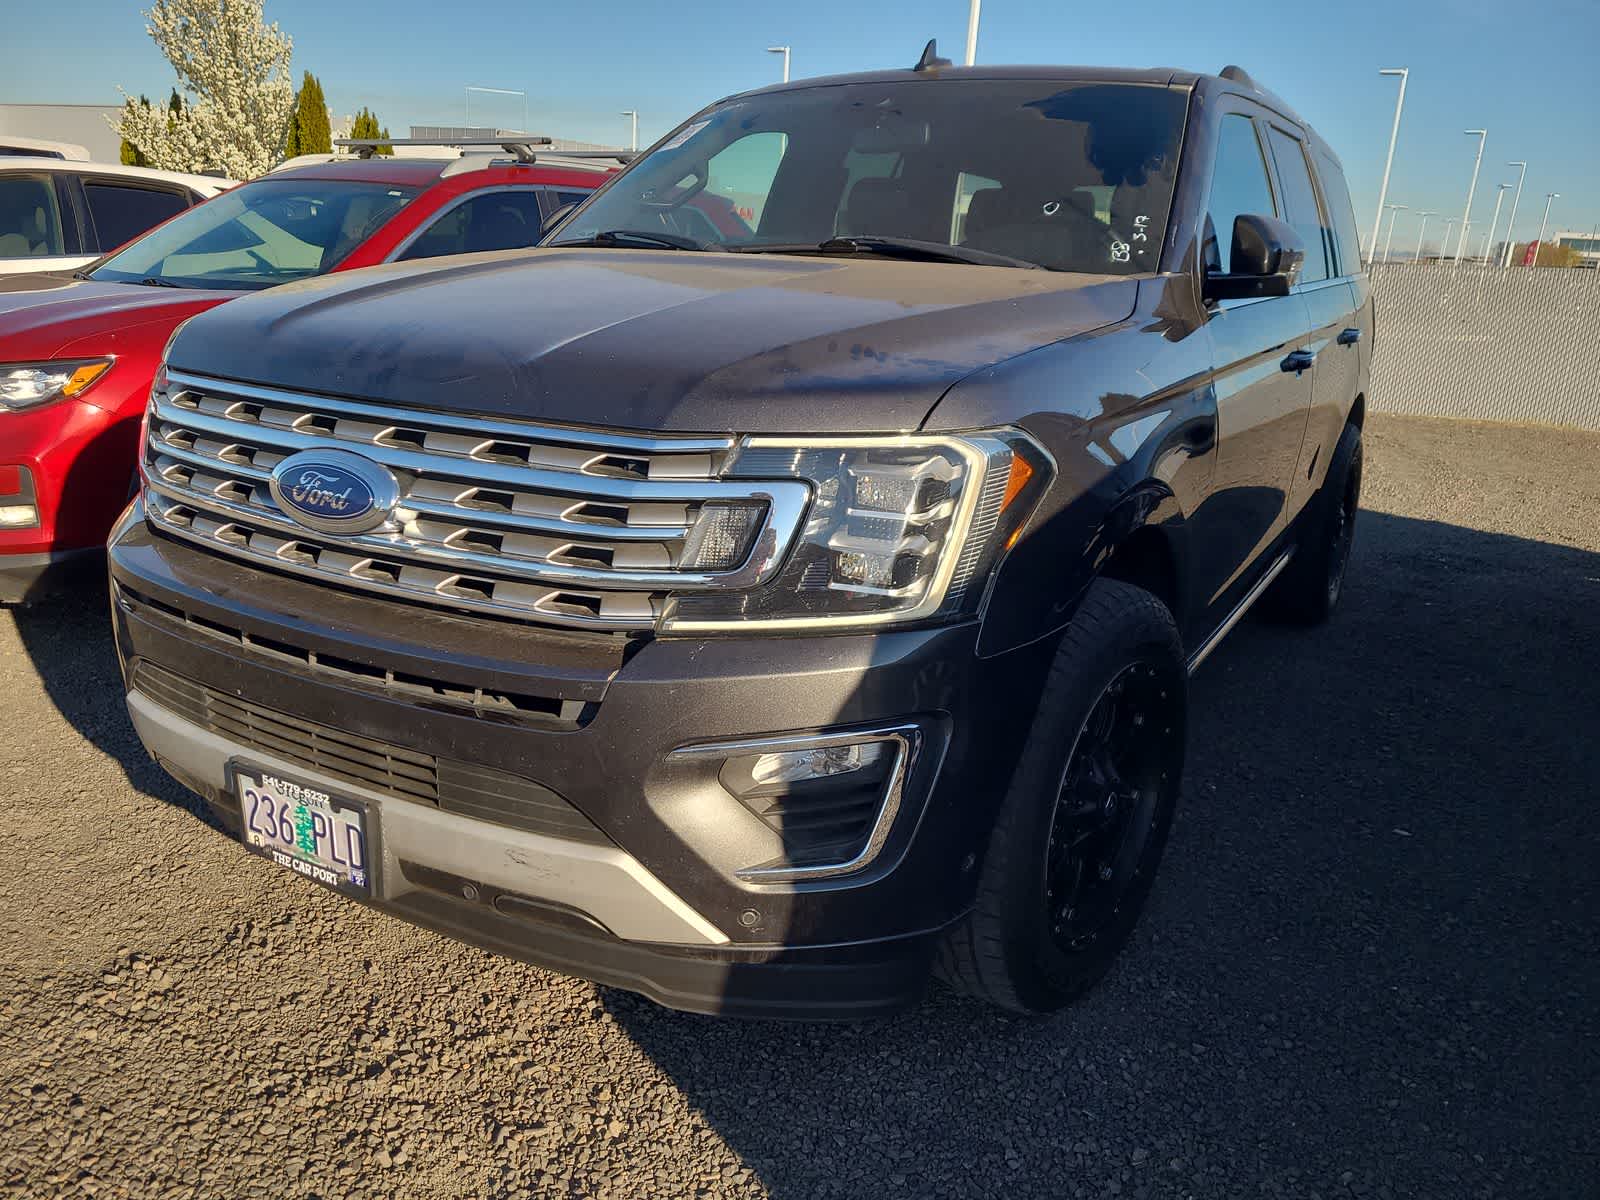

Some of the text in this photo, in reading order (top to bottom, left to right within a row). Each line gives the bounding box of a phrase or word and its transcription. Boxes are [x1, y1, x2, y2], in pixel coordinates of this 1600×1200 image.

[292, 470, 353, 511] Ford
[245, 788, 364, 870] 236 PLD
[272, 851, 292, 868] THE
[292, 859, 312, 876] CAR
[312, 865, 339, 886] PORT
